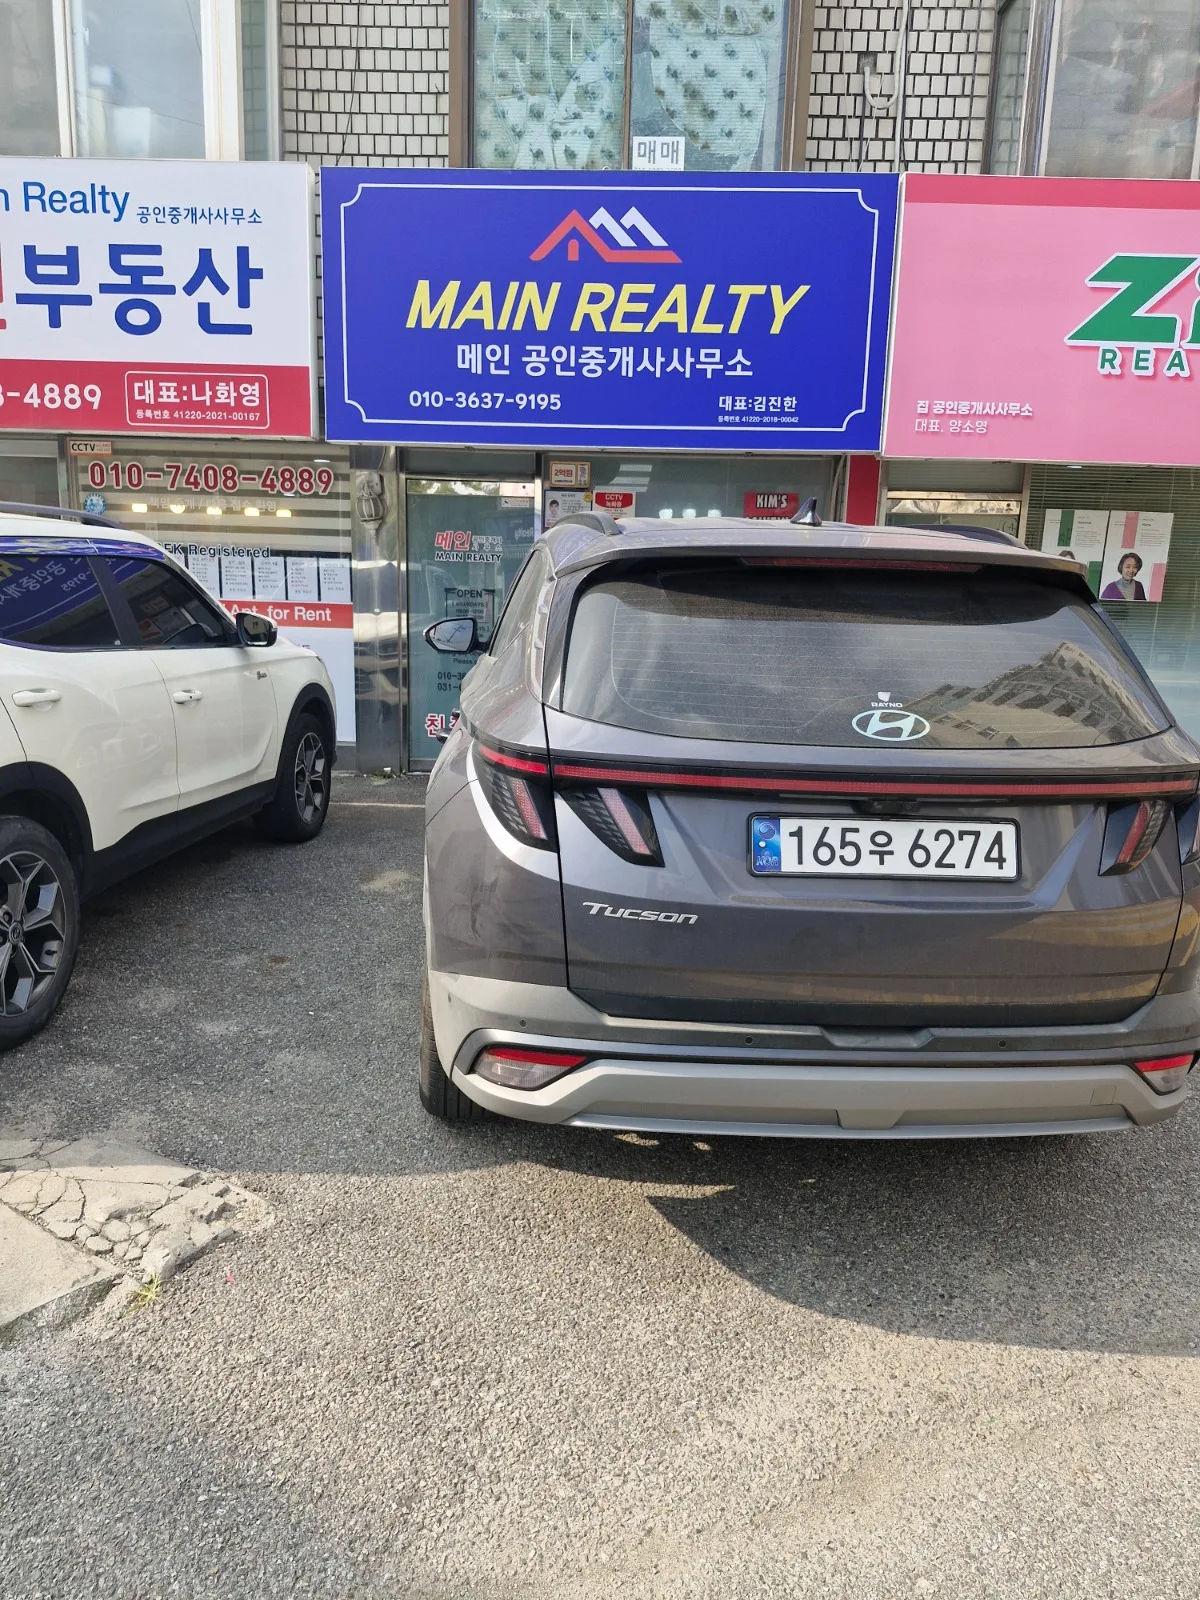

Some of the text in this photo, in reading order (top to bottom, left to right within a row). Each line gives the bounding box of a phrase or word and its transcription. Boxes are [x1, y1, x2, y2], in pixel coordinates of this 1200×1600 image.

[637, 140, 680, 165] 매매
[22, 181, 130, 222] Realty
[136, 206, 263, 225] 공인중개사사무소
[0, 241, 263, 335] 부동산
[405, 279, 810, 335] MAIN REALTY
[457, 343, 754, 379] 메인 공인중개사사무소
[0, 382, 102, 410] -4889
[133, 379, 261, 407] 대표:나화영
[408, 390, 562, 411] 010-3637-9195
[718, 395, 798, 412] 대표:김진한
[932, 401, 1034, 416] 공인중개사사무소
[173, 411, 261, 422] 41220-2021-00167
[949, 419, 988, 434] 양소영
[71, 442, 95, 452] CCTV
[87, 460, 335, 496] 010-7408-4889
[756, 494, 788, 509] KIM'S
[435, 531, 471, 551] 메인
[188, 544, 271, 558] Registered
[435, 552, 503, 562] MAIN REALTY
[456, 589, 483, 598] OPEN
[294, 606, 332, 622] Rent
[788, 825, 1007, 870] 165우 6274
